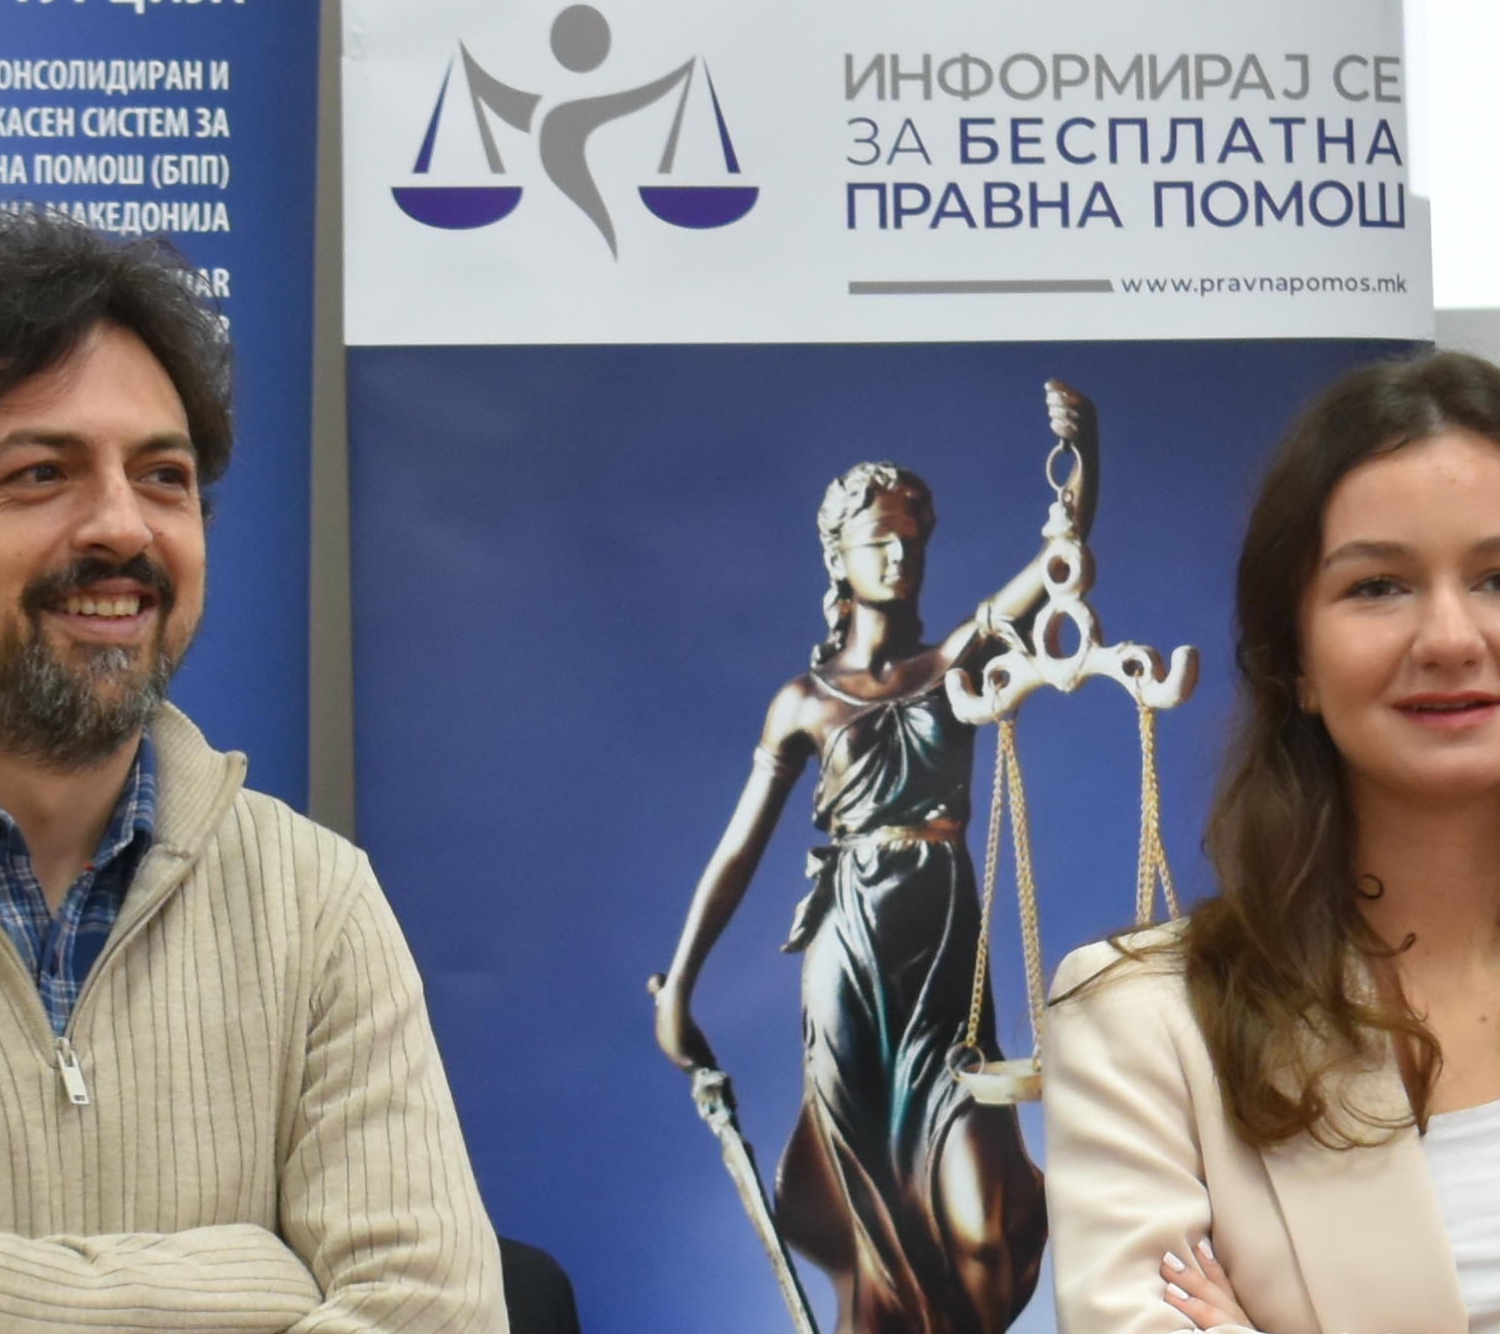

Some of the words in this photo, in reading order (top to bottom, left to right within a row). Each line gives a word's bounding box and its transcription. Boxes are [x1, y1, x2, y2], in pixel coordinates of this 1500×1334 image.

[209, 61, 231, 91] И
[843, 50, 1311, 105] ИНФОРМИРАЈ
[1333, 53, 1403, 104] СЕ
[82, 107, 191, 139] СИСТЕМ
[195, 107, 231, 139] ЗА
[845, 117, 932, 166] ЗА
[957, 115, 1405, 167] БЕСПЛАТНА
[34, 154, 147, 187] ПОМОШ
[151, 154, 231, 192] (БПП)
[845, 179, 1125, 231] ПРАВНА
[1152, 178, 1407, 230] ПОМОШ
[1120, 270, 1408, 297] www.pravnapomos.mk
